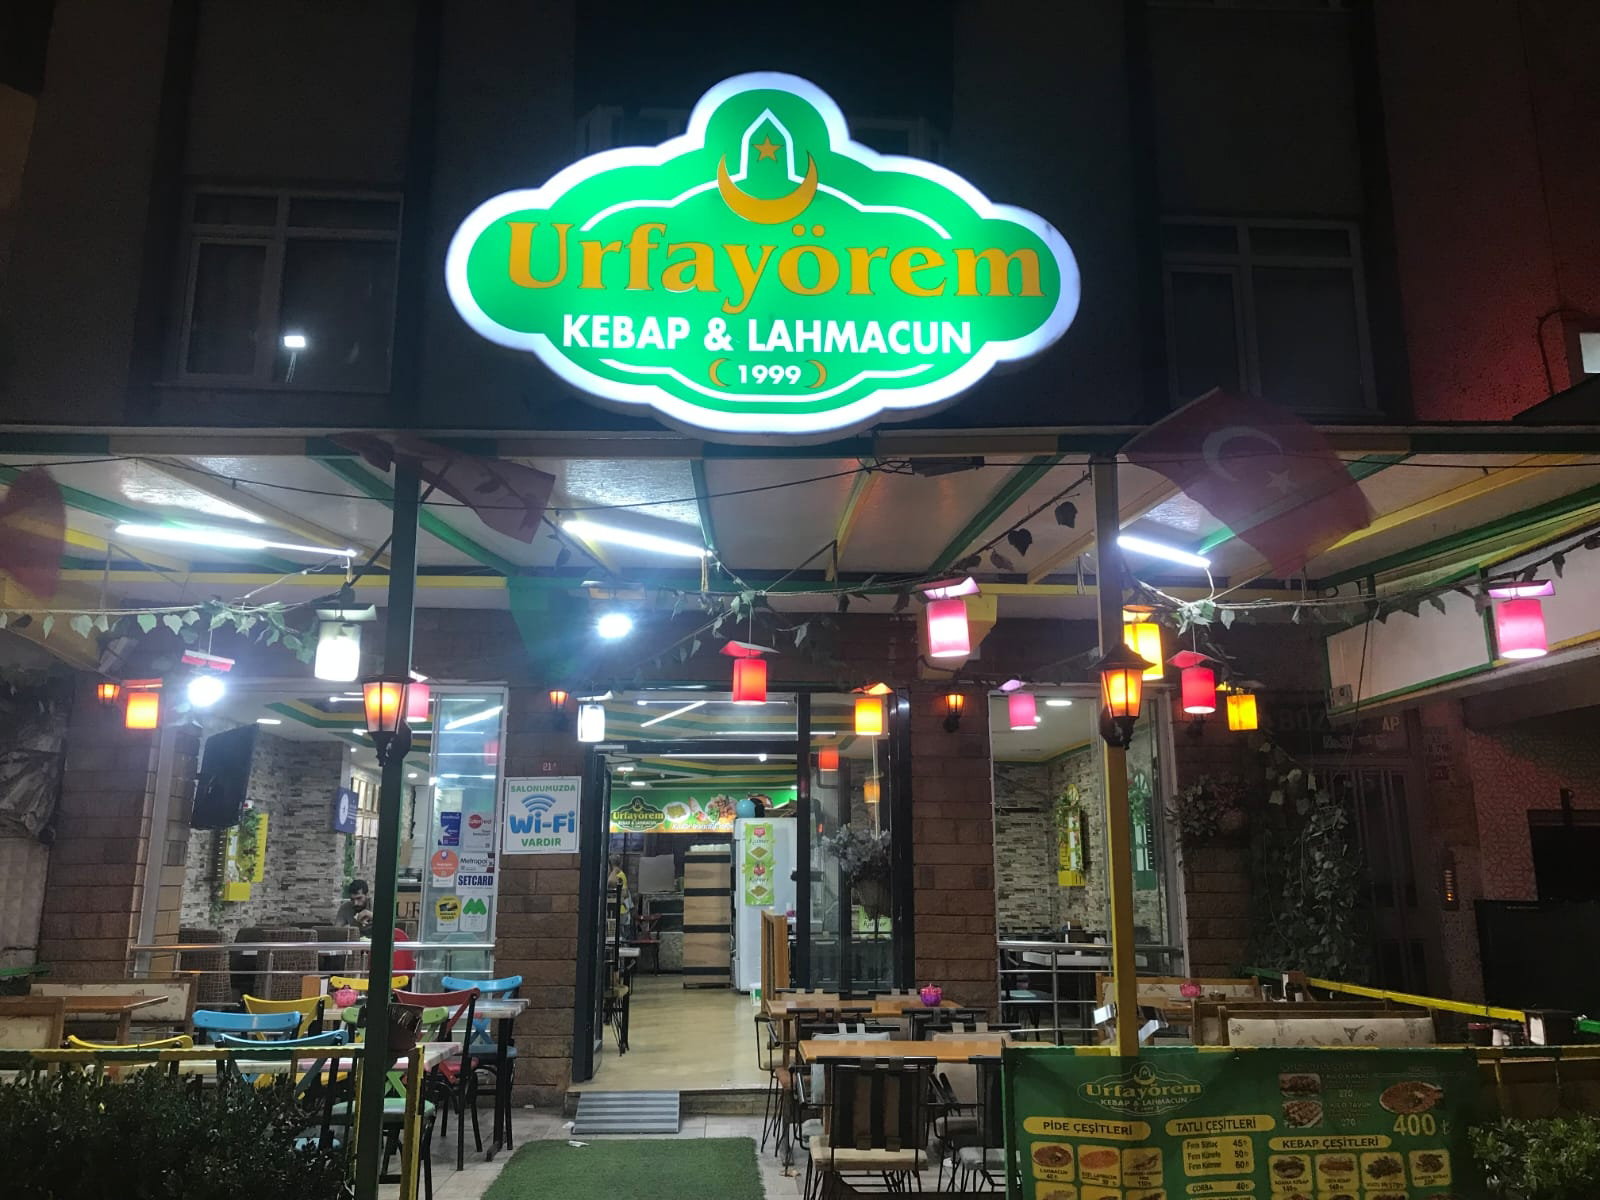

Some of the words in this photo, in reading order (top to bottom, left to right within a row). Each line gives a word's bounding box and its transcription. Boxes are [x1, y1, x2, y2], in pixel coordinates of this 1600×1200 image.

[506, 220, 1047, 315] Urfayörem
[562, 313, 690, 351] KEBAP
[703, 321, 732, 352] &
[747, 318, 972, 355] LAHMACUN
[737, 363, 802, 386] 1999
[511, 784, 576, 793] SALONUMUZDA
[509, 810, 576, 834] Wi-Fi
[521, 837, 562, 847] VARDIR
[457, 875, 494, 886] SETCARD
[1086, 1083, 1201, 1101] Urfayörem
[1100, 1099, 1131, 1107] KEBAP
[1142, 1096, 1188, 1106] LAHMACUN
[1043, 1120, 1070, 1132] PİDE
[1073, 1122, 1133, 1136] ÇEŞİTLERİ
[1175, 1120, 1203, 1132] TATLI
[1205, 1116, 1257, 1133] ÇEŞİTLERİ
[1392, 1113, 1436, 1137] 400
[1282, 1139, 1319, 1149] KEBAP
[1322, 1136, 1379, 1150] ÇEŞİTLERİ
